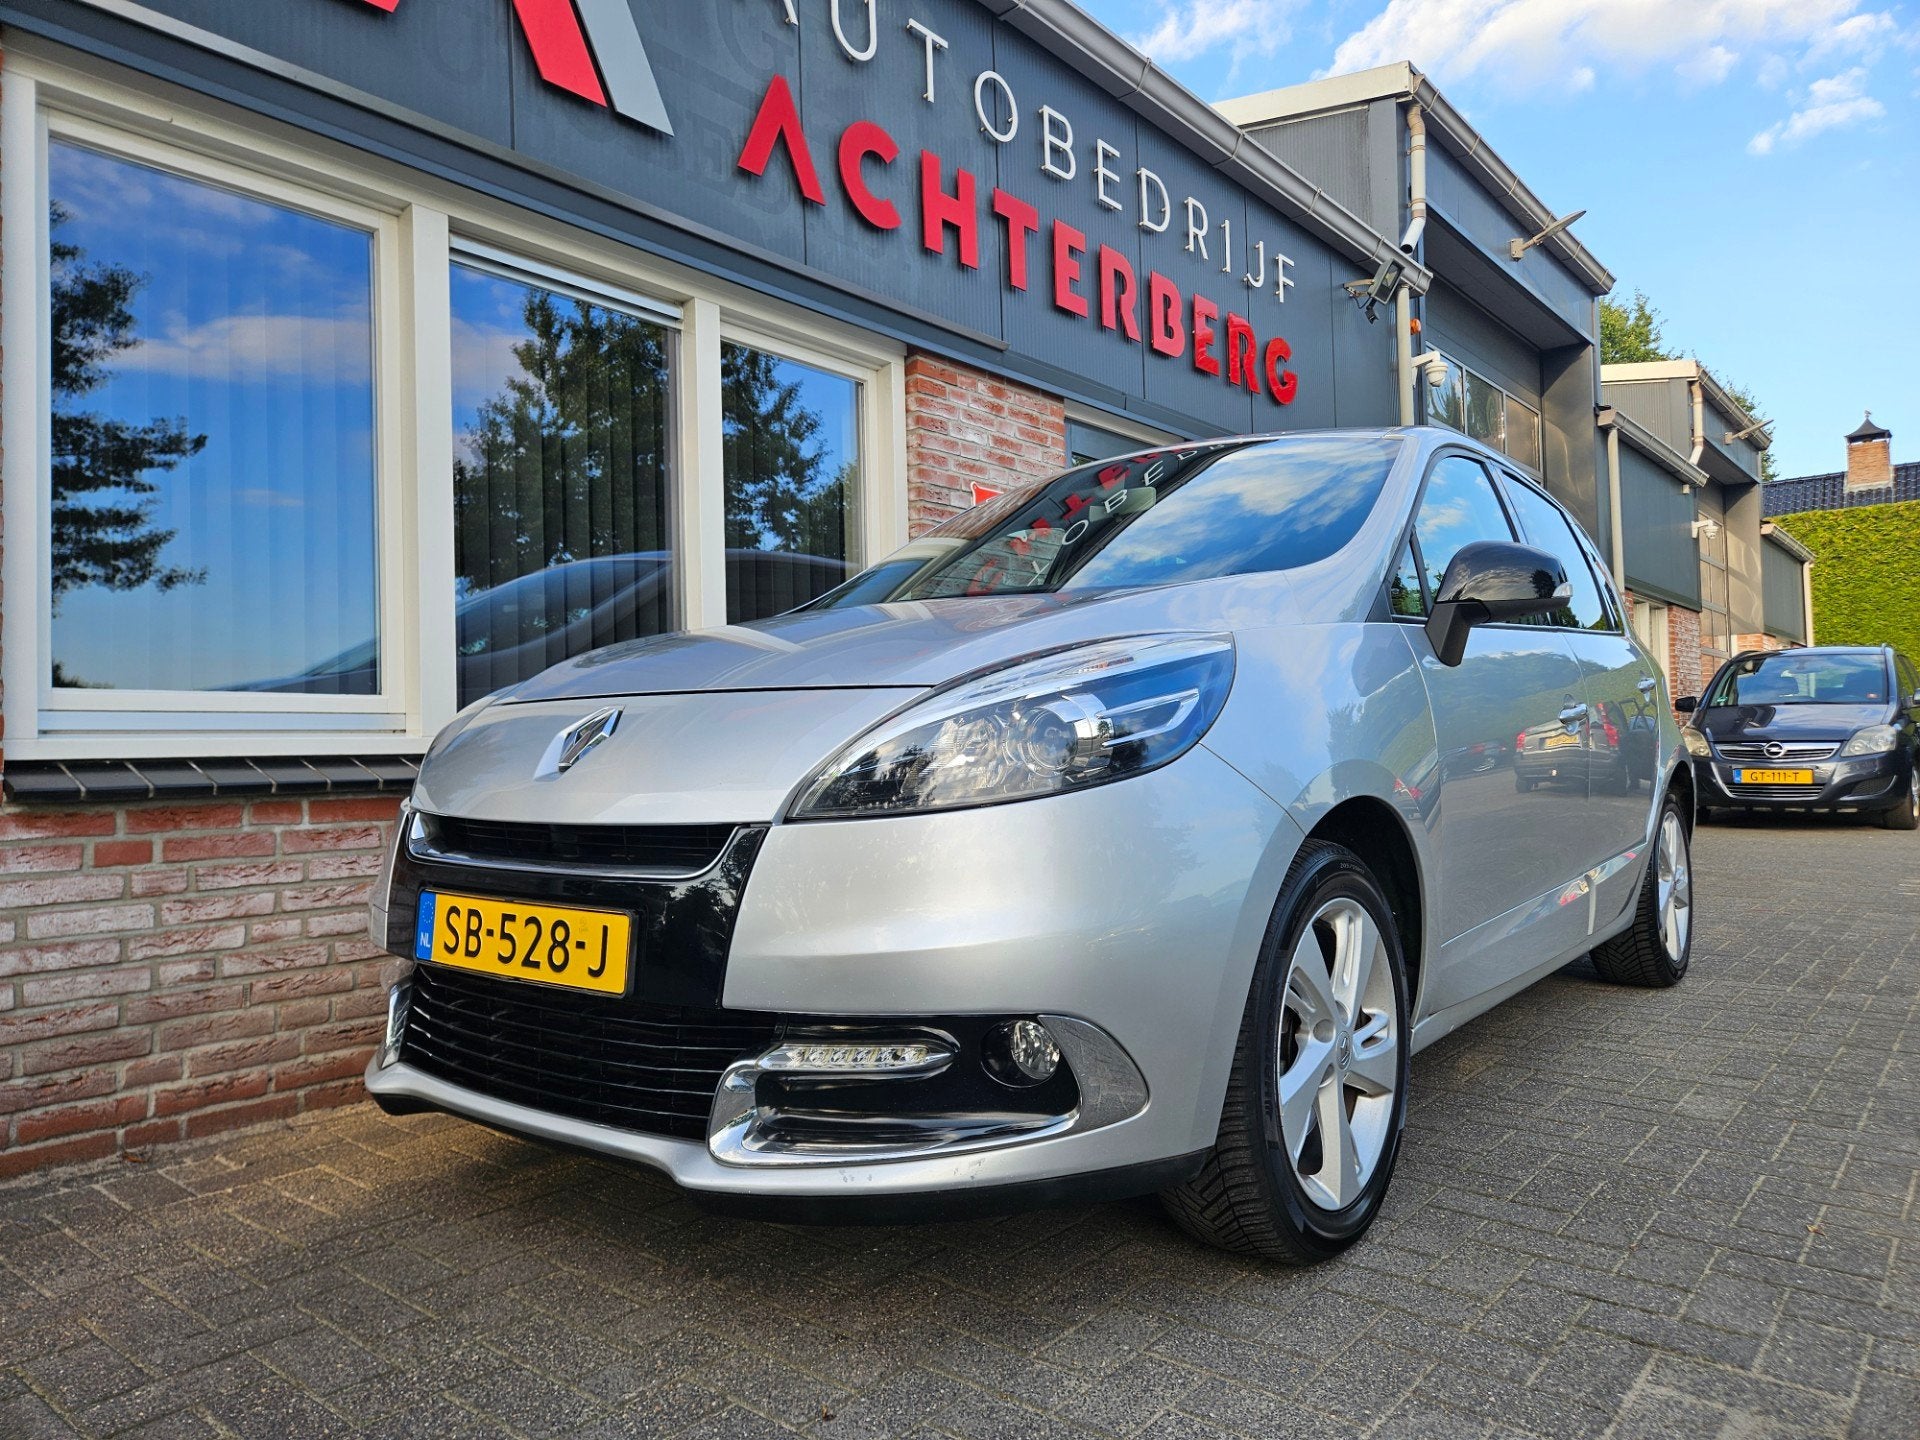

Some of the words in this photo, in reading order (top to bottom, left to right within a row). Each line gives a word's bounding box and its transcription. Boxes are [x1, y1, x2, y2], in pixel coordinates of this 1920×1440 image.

[737, 73, 1298, 406] ACHTERBERG
[783, 0, 1296, 303] UTOBEDRIJF
[1750, 771, 1800, 782] GT-111-T
[420, 931, 431, 948] NL
[443, 904, 609, 978] SB-528-J
